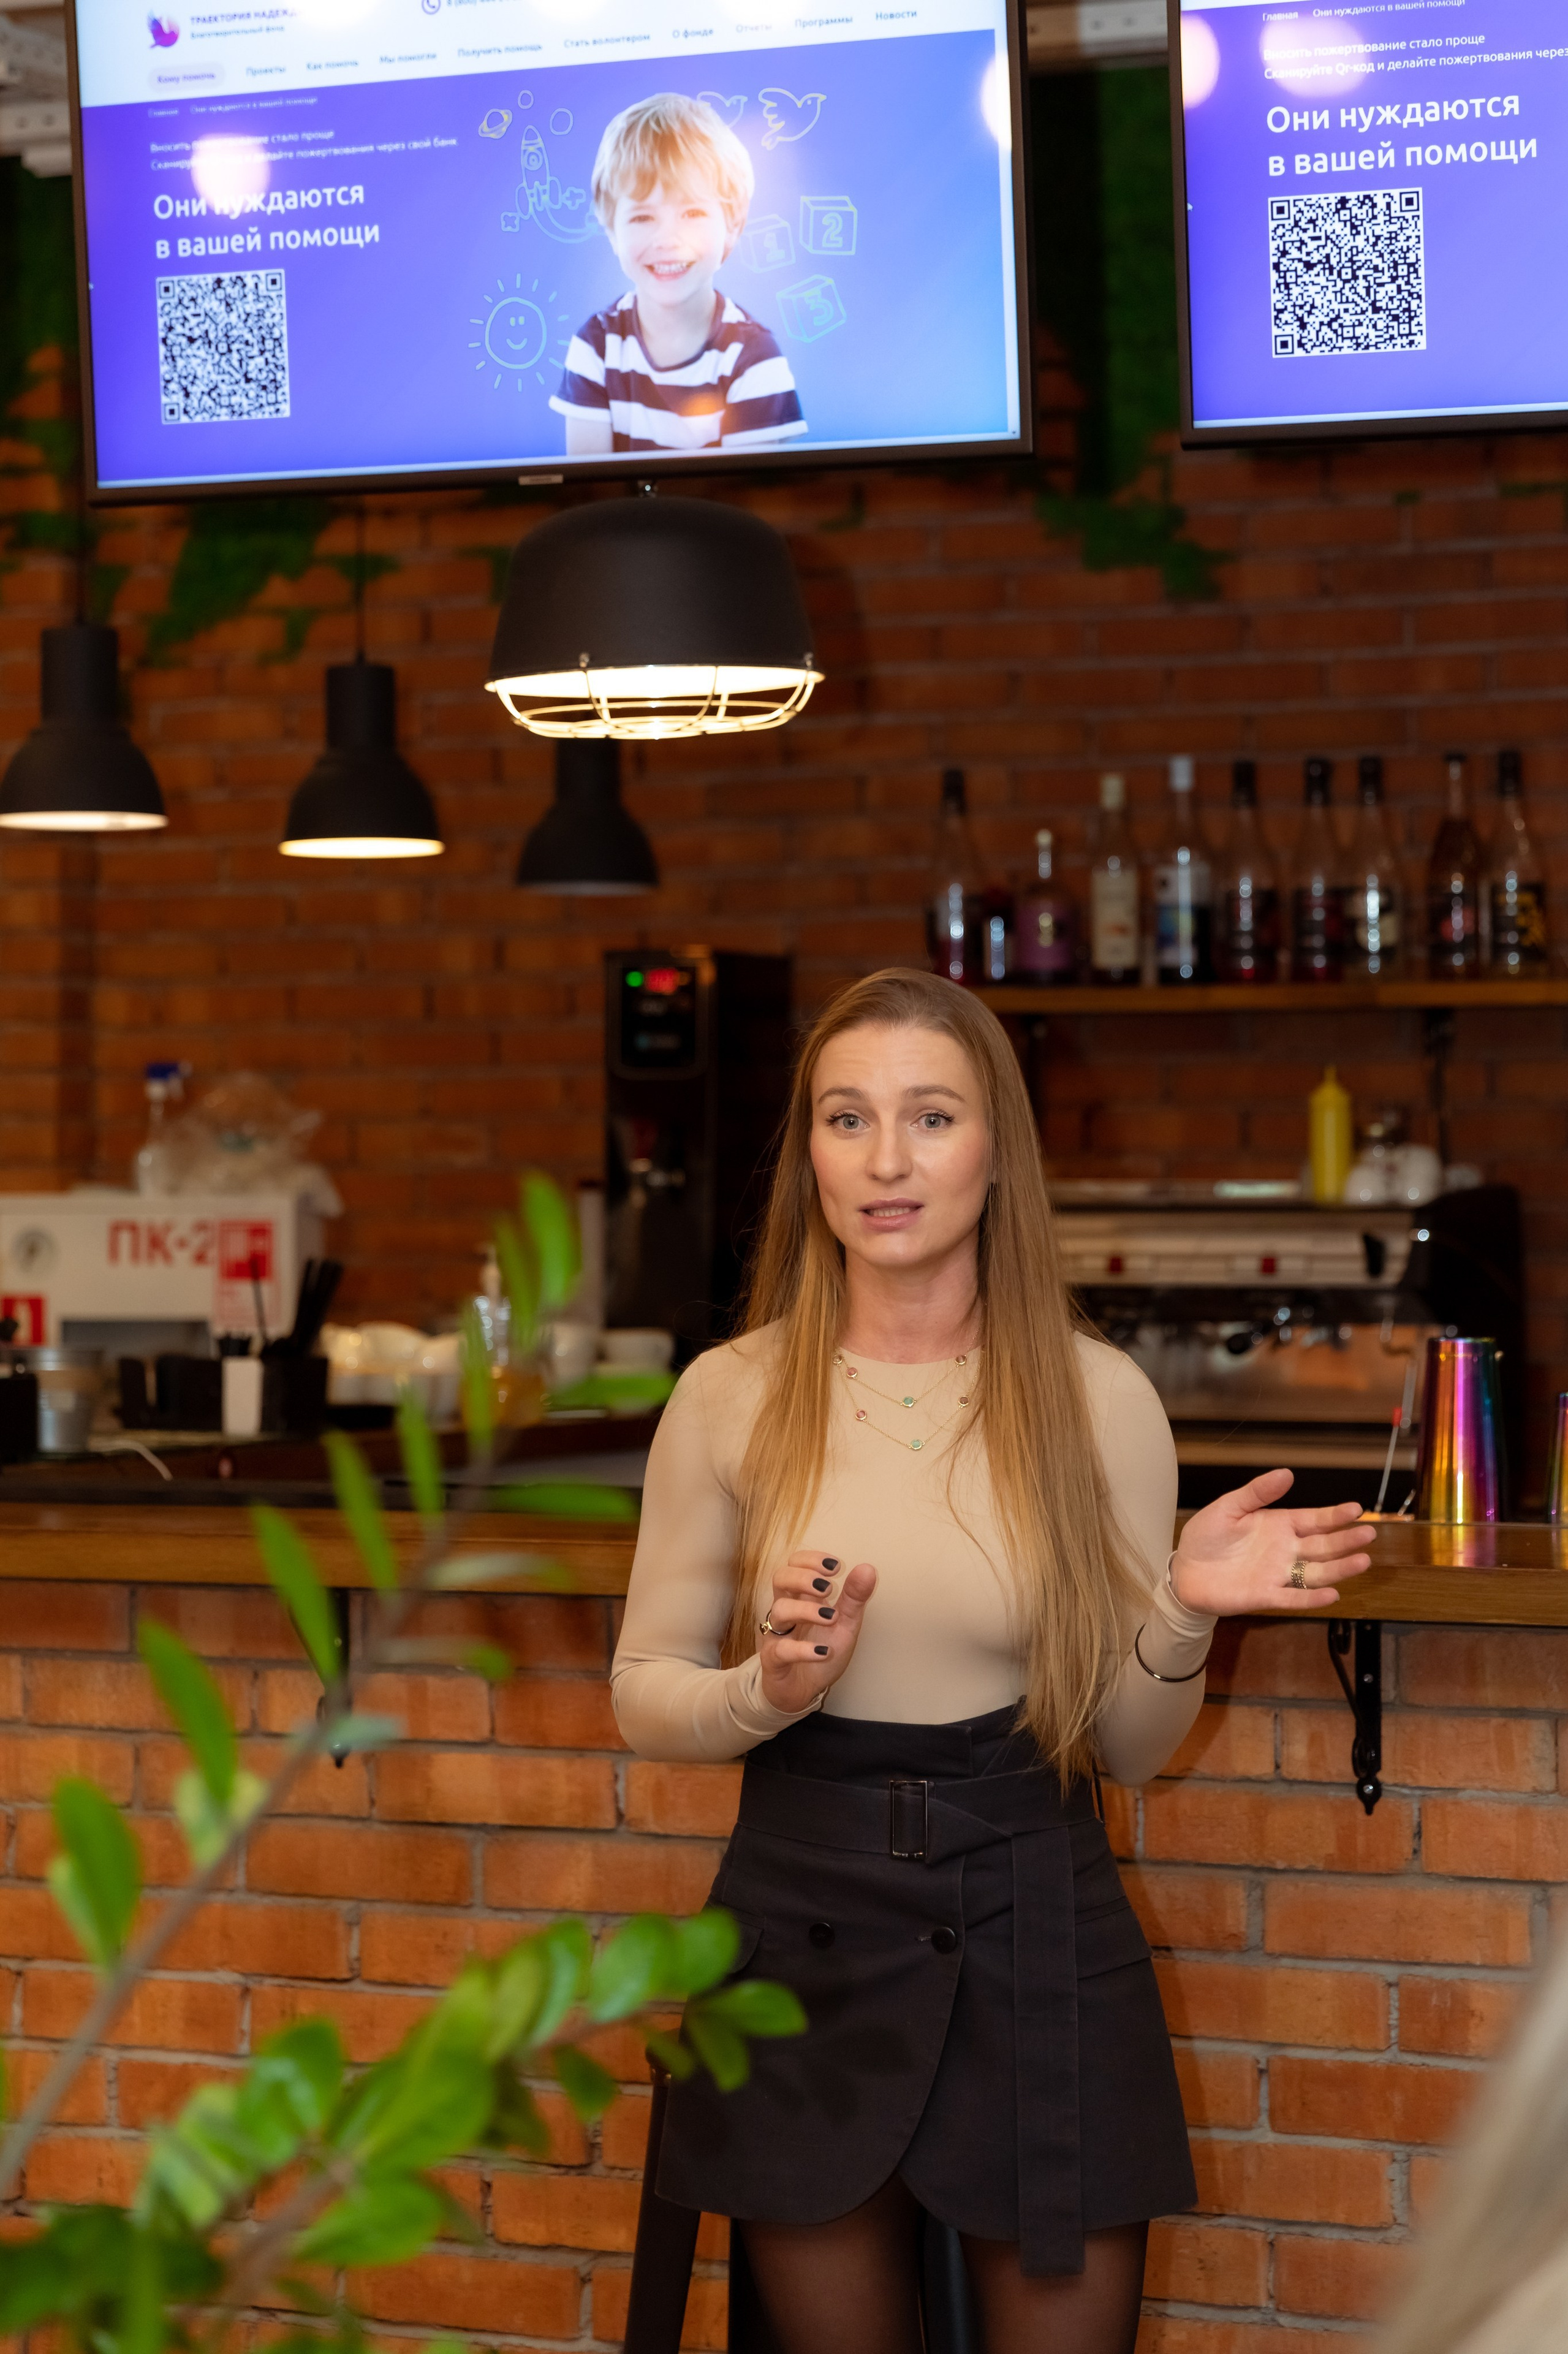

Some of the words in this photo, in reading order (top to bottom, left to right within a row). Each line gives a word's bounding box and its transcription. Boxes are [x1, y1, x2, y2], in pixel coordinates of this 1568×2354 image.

[191, 12, 251, 25] ТРАЕКТОРИЯ
[254, 8, 298, 20] НАДЕЖД
[876, 10, 917, 21] Новости
[1263, 12, 1298, 21] Главная
[1312, 9, 1332, 18] Они
[1334, 5, 1385, 17] нуждаются
[1395, 0, 1425, 10] вашей
[1427, 0, 1465, 9] помощи
[795, 15, 853, 29] Программы
[672, 29, 680, 38] О
[682, 28, 714, 38] фонде
[564, 39, 590, 48] Стать
[1264, 48, 1312, 60] Вносить
[1314, 41, 1407, 58] пожертвование
[1409, 38, 1443, 49] стало
[1445, 35, 1485, 48] проще
[458, 47, 502, 59] Получить
[246, 66, 286, 77] Проекты
[1264, 64, 1333, 79] Сканируйте
[1336, 62, 1375, 76] Qr-код
[1377, 62, 1385, 70] и
[1387, 56, 1436, 72] делайте
[1439, 50, 1532, 66] пожертвования
[1266, 105, 1330, 133] Они
[1340, 95, 1520, 132] нуждаются
[271, 133, 299, 142] стало
[301, 131, 335, 142] проще
[407, 137, 432, 150] свой
[433, 135, 457, 148] банк
[1268, 155, 1286, 177] в
[1295, 140, 1395, 175] вашей
[1406, 139, 1537, 167] помощи
[154, 194, 206, 219] Они
[214, 185, 365, 219] нуждаются
[822, 212, 843, 248] 2
[156, 239, 170, 259] в
[178, 226, 262, 258] вашей
[270, 224, 379, 250] помощи
